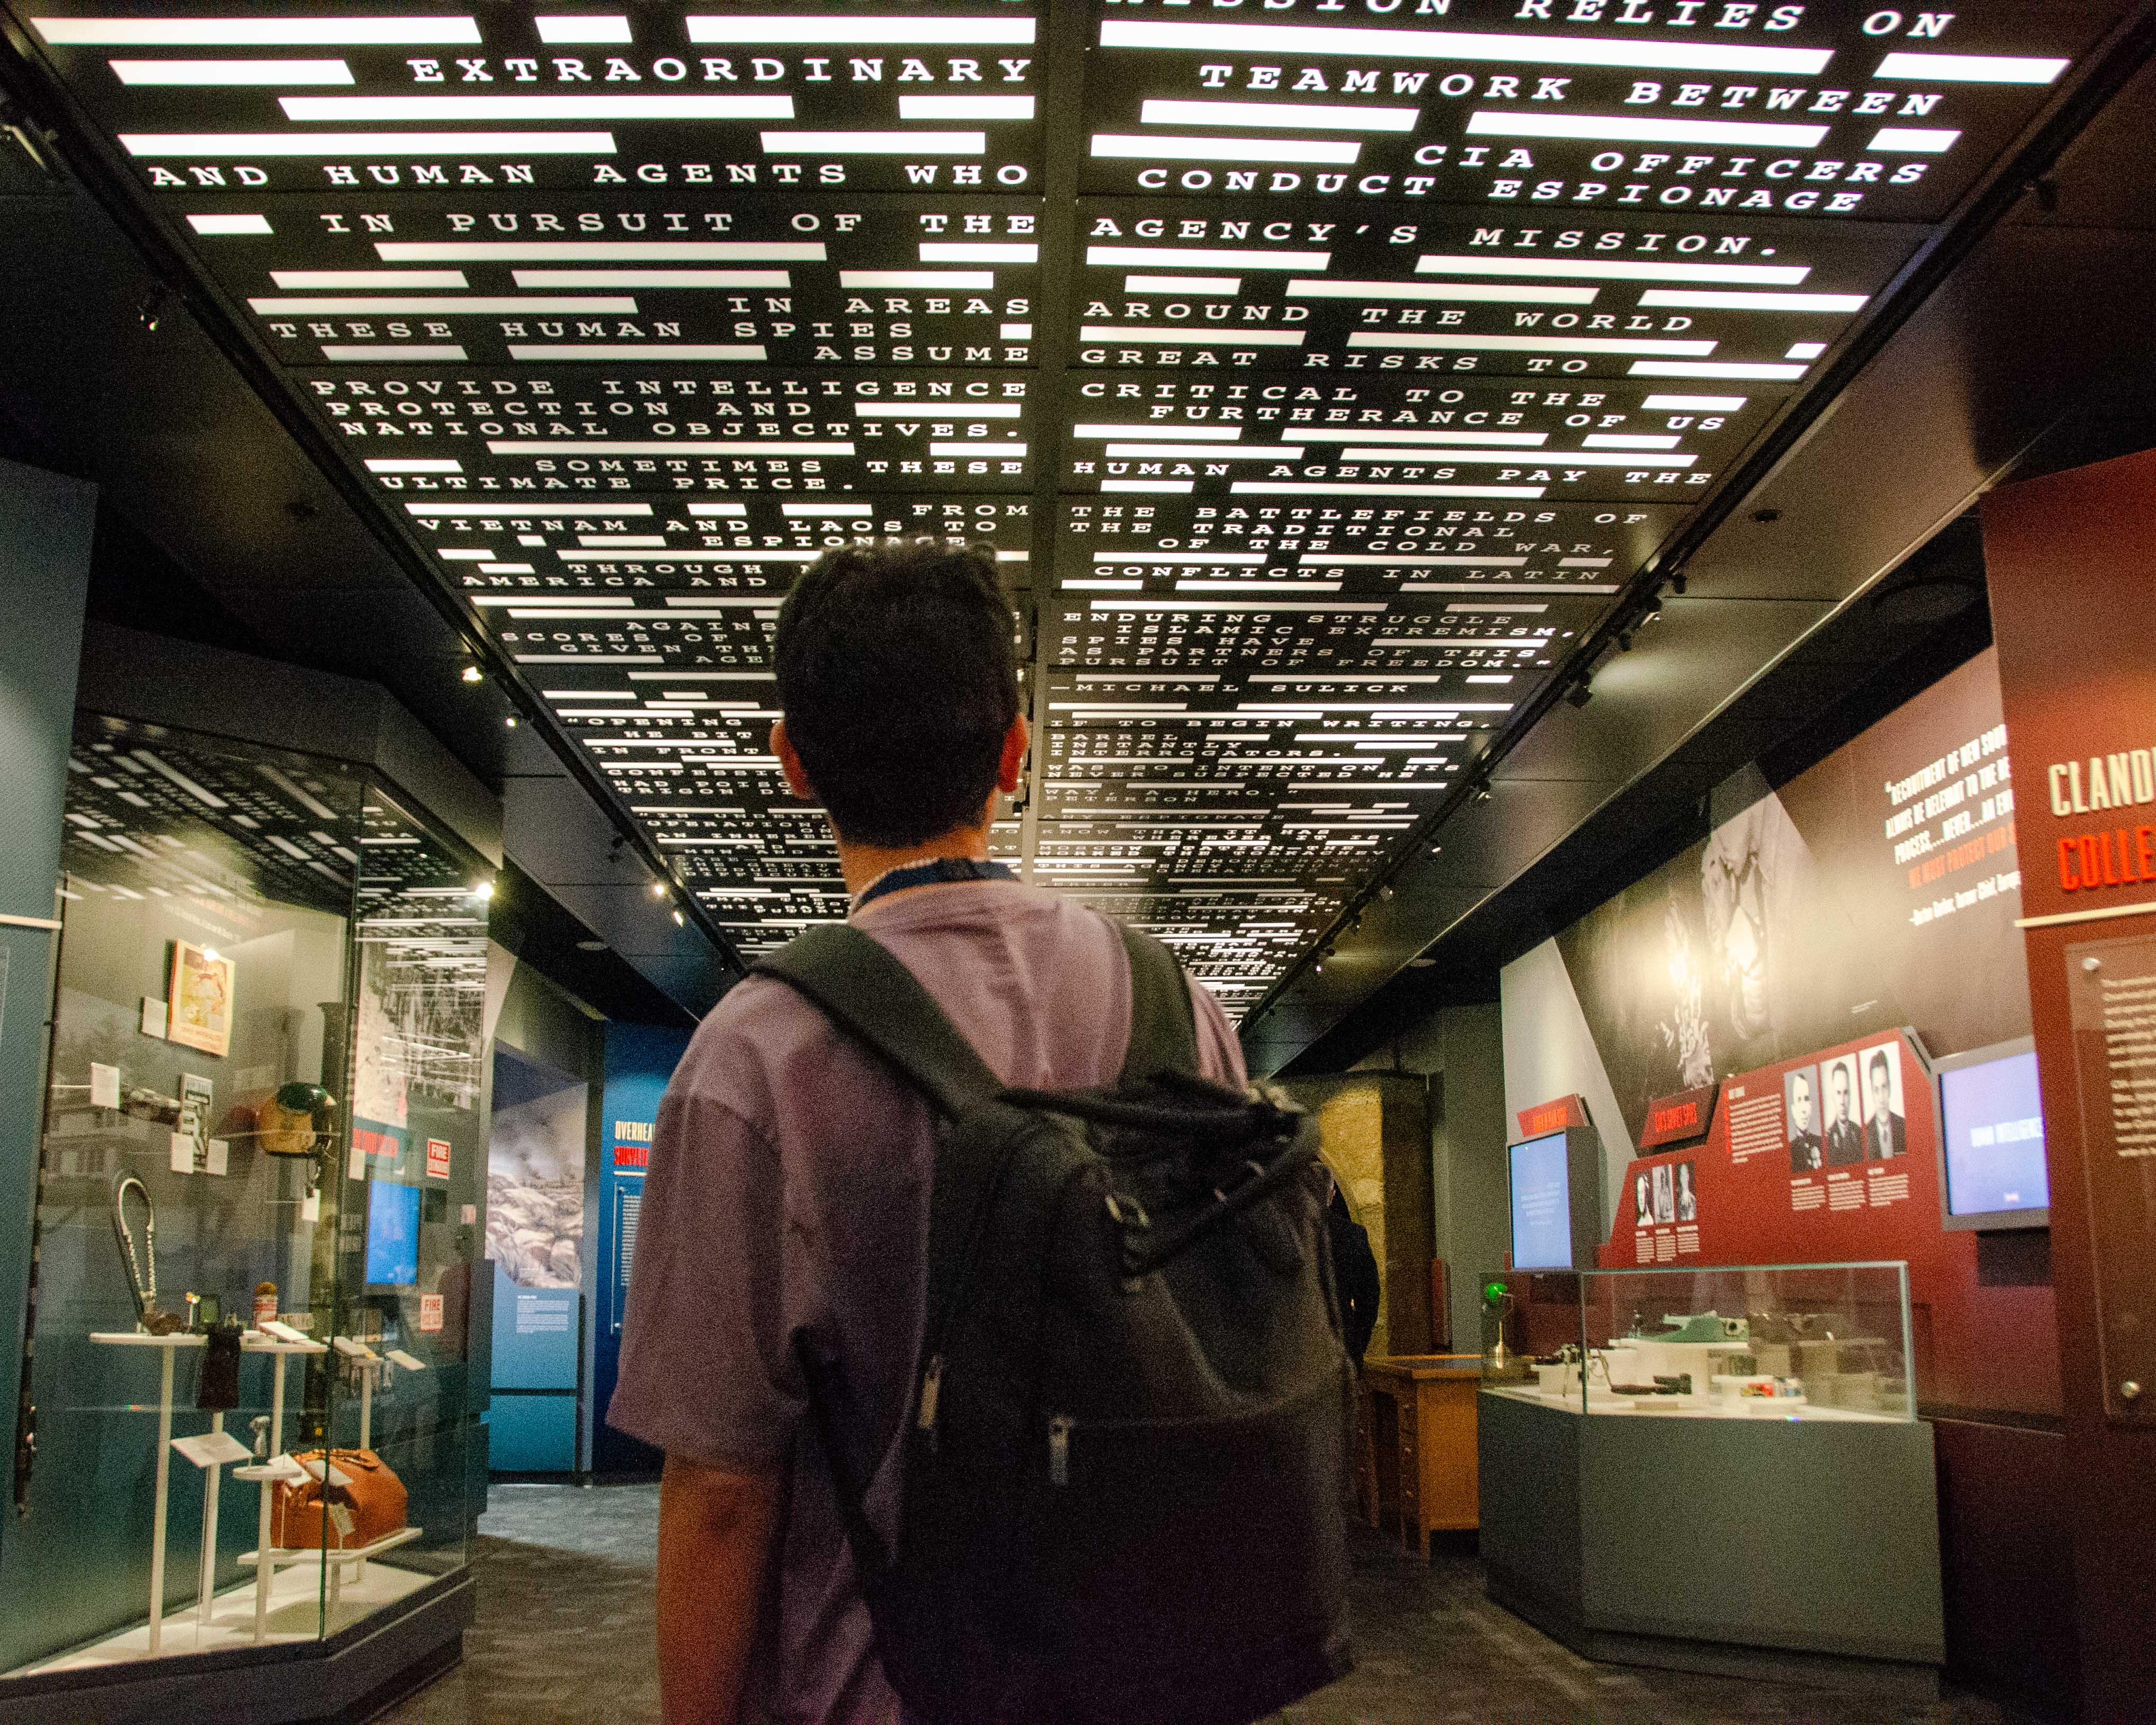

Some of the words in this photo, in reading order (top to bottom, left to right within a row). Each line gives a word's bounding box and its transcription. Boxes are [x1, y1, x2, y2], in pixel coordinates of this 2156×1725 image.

[1514, 0, 1805, 31] RELIES
[1862, 11, 1955, 38] ON
[406, 58, 1031, 82] EXTRAORDINARY
[1199, 65, 1572, 101] TEAMWORK
[1624, 81, 1943, 116] BETWEEN
[1414, 145, 1534, 169] CIA
[1591, 152, 1928, 184] OFFICERS
[148, 166, 268, 186] AND
[323, 165, 534, 185] HUMAN
[593, 164, 846, 184] AGENTS
[905, 165, 1028, 185] WHO
[1137, 169, 1436, 195] CONDUCT
[1487, 179, 1863, 212] ESPIONAGE
[320, 214, 394, 232] IN
[446, 213, 732, 232] PURSUIT
[791, 213, 862, 232] OF
[920, 215, 1035, 234] THE
[1469, 228, 1776, 256] MISSION.
[727, 297, 791, 313] IN
[845, 298, 1029, 315] AREAS
[1083, 302, 1309, 321] AROUND
[1362, 308, 1466, 325] THE
[1515, 312, 1692, 331] WORLD
[269, 322, 452, 338] THESE
[499, 322, 681, 337] HUMAN
[734, 322, 912, 338] SPIES
[814, 346, 1028, 362] ASSUME
[1081, 349, 1257, 366] GREAT
[1303, 353, 1478, 370] RISKS
[1527, 359, 1588, 373] TO
[310, 381, 554, 395] PROVIDE
[602, 381, 1026, 397] INTELLIGENCE
[1081, 383, 1357, 401] CRITICAL
[1405, 389, 1464, 403] TO
[1511, 391, 1606, 407] THE
[325, 401, 669, 416] PROTECTION
[716, 402, 811, 416] AND
[1149, 405, 1524, 425] FURTHERANCE
[1565, 414, 1627, 427] OF
[1666, 416, 1725, 430] US
[339, 422, 608, 435] NATIONAL
[653, 423, 1018, 437] OBJECTIVES.
[535, 460, 821, 473] SOMETIMES
[866, 461, 1022, 474] THESE
[1073, 462, 1229, 476] HUMAN
[1268, 465, 1456, 479] AGENTS
[1496, 469, 1587, 482] PAY
[1625, 471, 1712, 484] THE
[379, 477, 631, 489] ULTIMATE
[673, 478, 853, 490] PRICE.
[912, 505, 1028, 516] FROM
[1071, 506, 1155, 517] THE
[1195, 507, 1556, 523] BATTLEFIELDS
[1594, 513, 1648, 524] OF
[417, 519, 627, 531] VIETNAM
[666, 520, 748, 532] AND
[789, 521, 902, 532] LAOS
[944, 521, 997, 532] TO
[1070, 522, 1152, 533] THE
[1192, 523, 1514, 537] TRADITIONAL
[1158, 538, 1210, 549] OF
[1249, 539, 1329, 550] THE
[1367, 541, 1476, 551] COLD
[1515, 543, 1613, 555] WAR,
[567, 564, 763, 574] THROUGH
[1094, 566, 1344, 578] CONFLICTS
[1383, 569, 1432, 578] IN
[1466, 570, 1600, 580] LATIN
[462, 576, 654, 586] AMERICA
[691, 577, 766, 586] AND
[1063, 613, 1271, 623] ENDURING
[1307, 615, 1512, 624] STRUGGLE
[501, 632, 650, 642] SCORES
[684, 634, 728, 642] OF
[1062, 636, 1182, 645] SPIES
[1218, 637, 1314, 645] HAVE
[1117, 625, 1293, 634] ISLAMIC
[1328, 627, 1574, 638] EXTREMISM,
[560, 644, 681, 653] GIVEN
[1137, 647, 1333, 656] PARTNERS
[1445, 649, 1536, 658] THIS
[1058, 657, 1228, 666] PURSUIT
[1050, 741, 1241, 749] INSTANTLY
[1050, 749, 1340, 757] INTERROGATORS.
[2049, 746, 2156, 816] CLAND
[615, 1120, 655, 1142] OVERHEA
[431, 1144, 448, 1160] FIRE
[424, 1299, 441, 1311] FIRE
